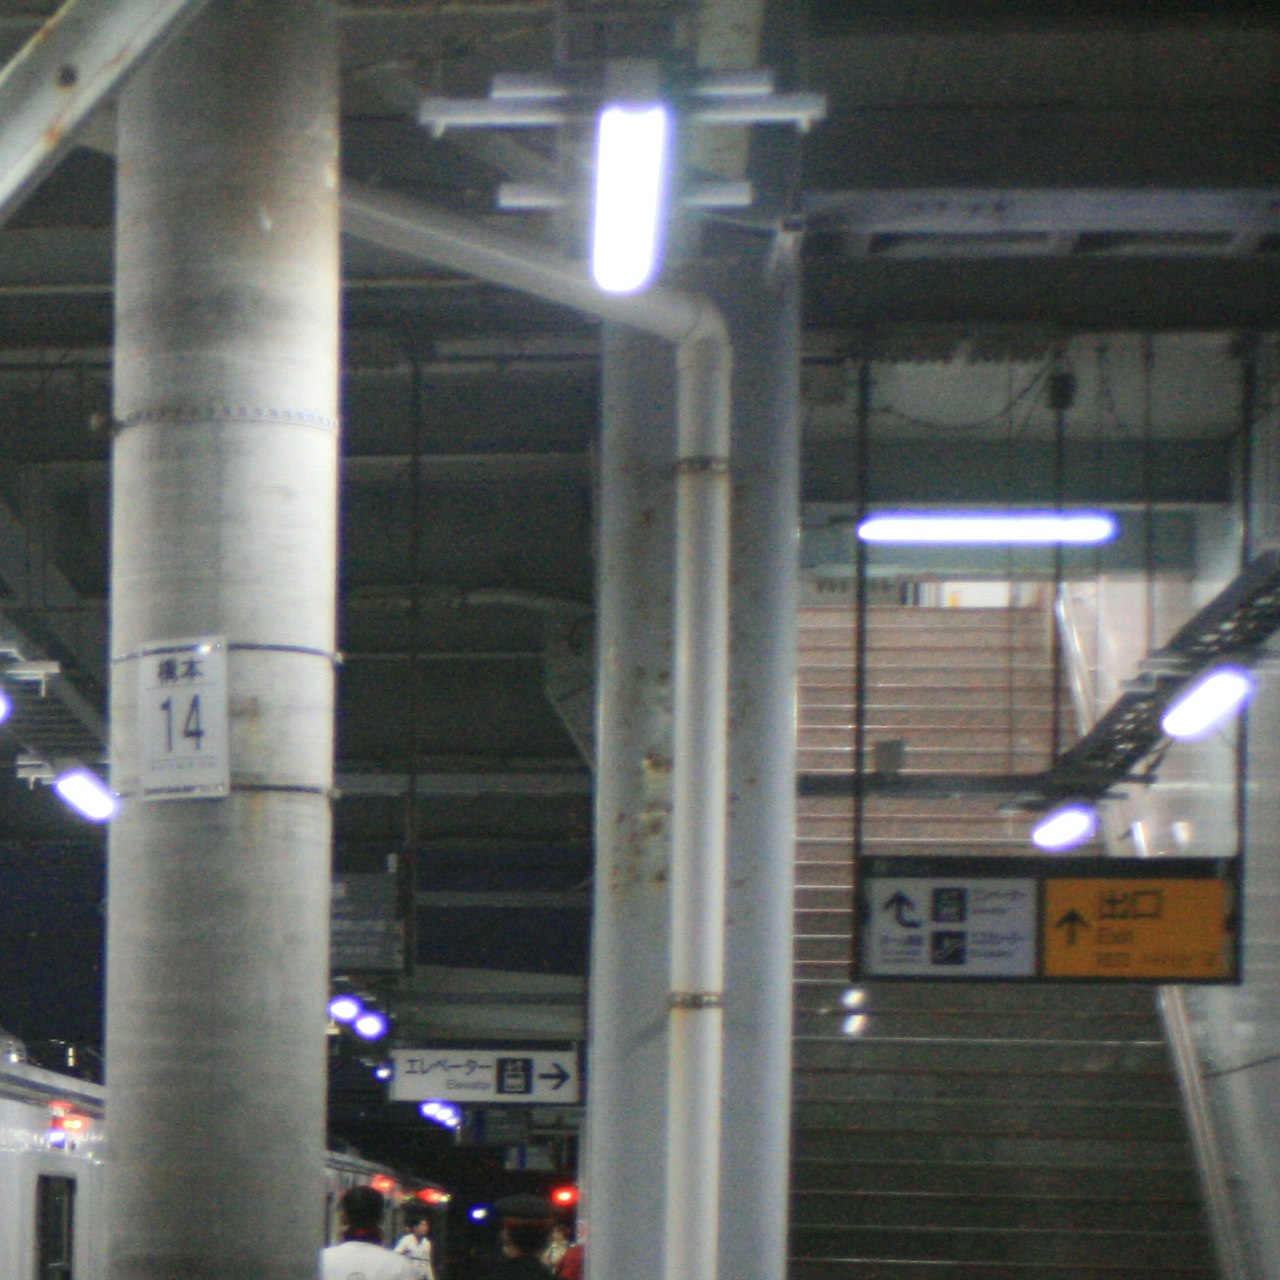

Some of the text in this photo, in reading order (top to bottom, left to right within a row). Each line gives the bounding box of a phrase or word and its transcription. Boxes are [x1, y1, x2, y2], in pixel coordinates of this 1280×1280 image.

[160, 694, 205, 752] 14
[1099, 890, 1163, 919] 出口
[405, 1057, 492, 1077] エレベーター
